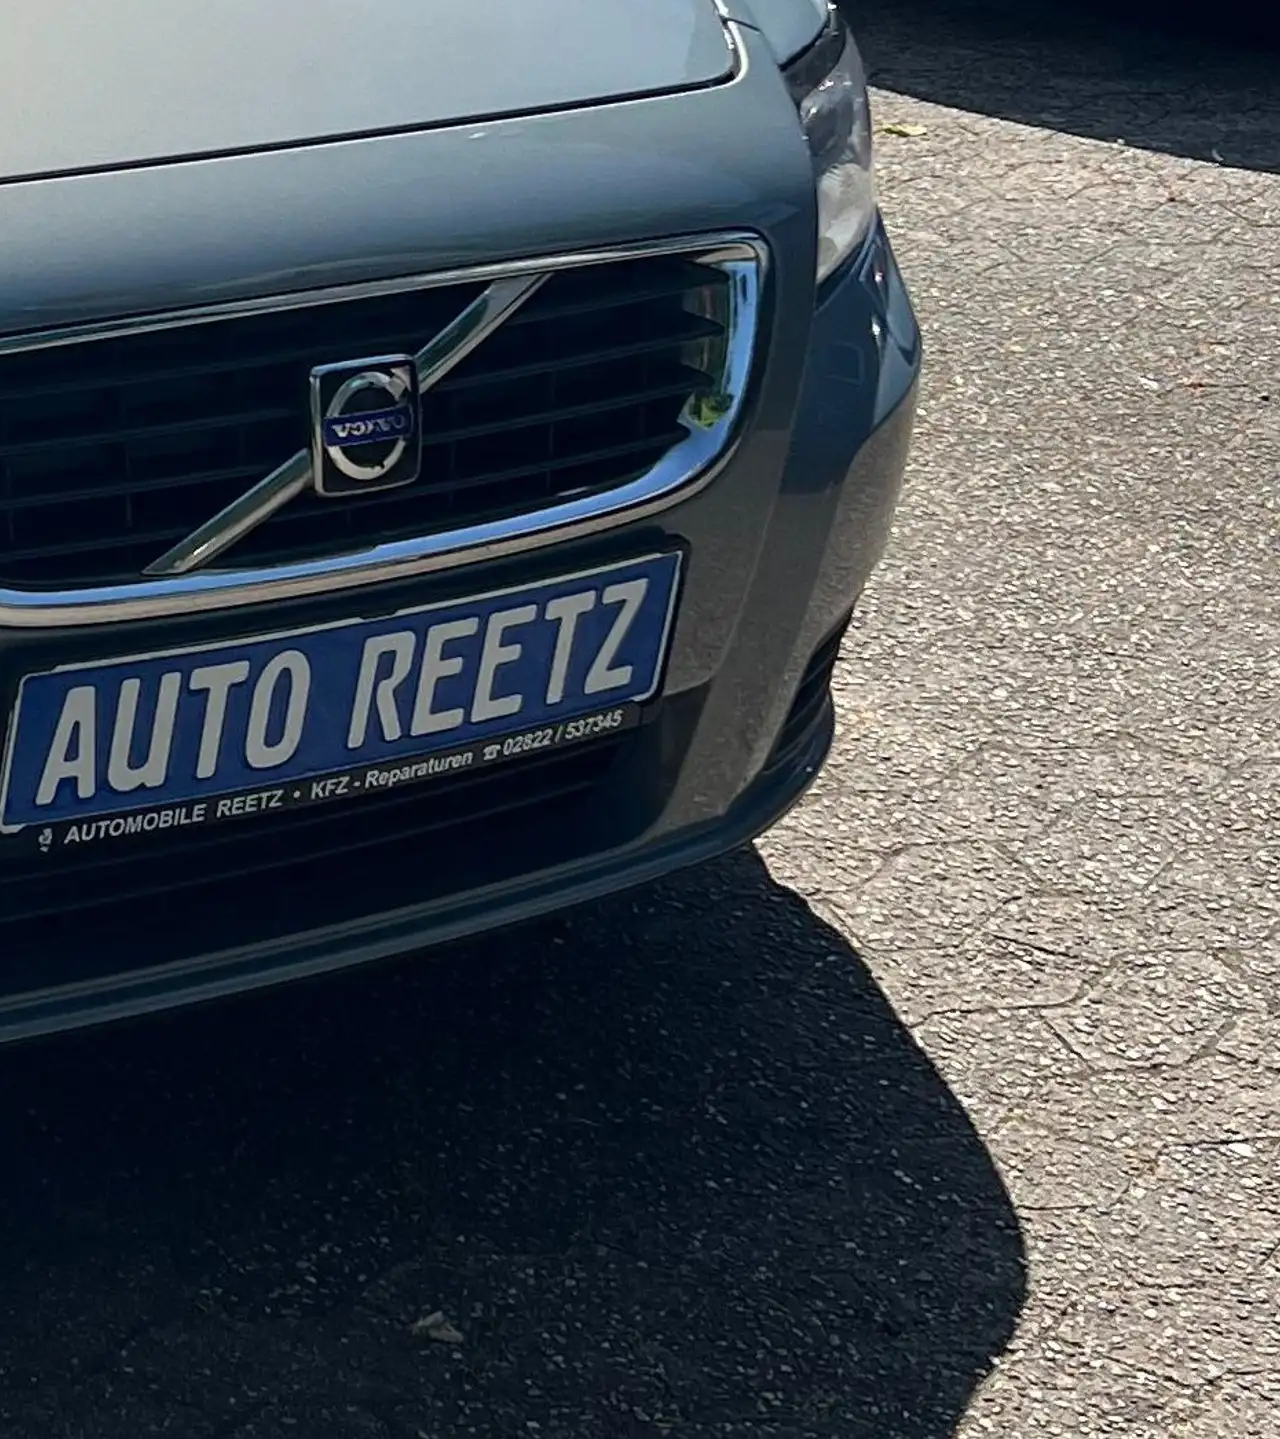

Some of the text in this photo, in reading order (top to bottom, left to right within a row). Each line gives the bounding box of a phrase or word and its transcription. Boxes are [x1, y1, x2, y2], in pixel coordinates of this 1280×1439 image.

[331, 413, 406, 438] VOLVO
[34, 577, 649, 807] AUTO REETZ
[63, 803, 207, 845] AUTOMOBILE
[216, 790, 284, 819] REETZ
[364, 751, 473, 789] Reparaturen
